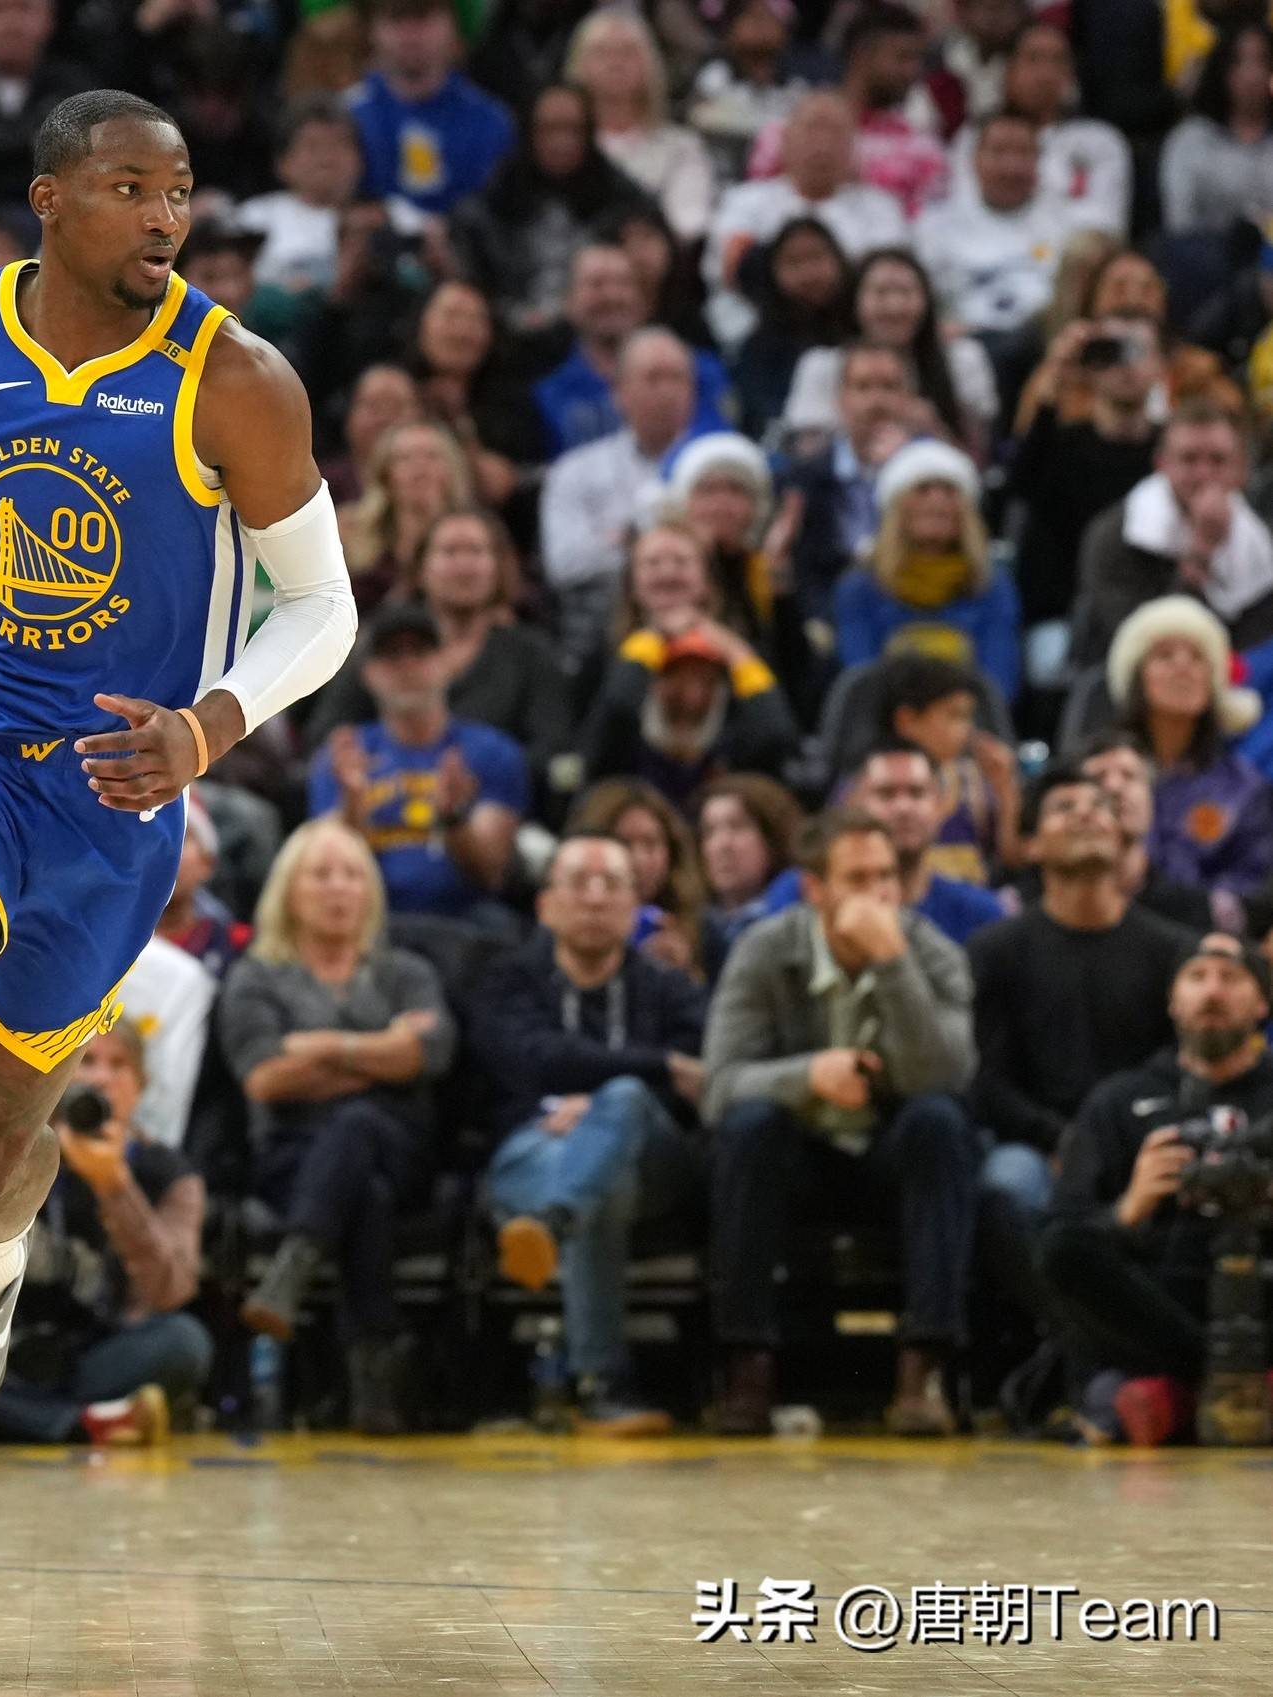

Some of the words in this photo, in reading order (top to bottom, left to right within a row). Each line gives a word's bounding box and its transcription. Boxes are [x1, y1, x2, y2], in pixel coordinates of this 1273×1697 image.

[163, 342, 180, 358] 16
[96, 392, 164, 415] Rakuten
[69, 447, 132, 505] STATE
[51, 507, 107, 553] 00
